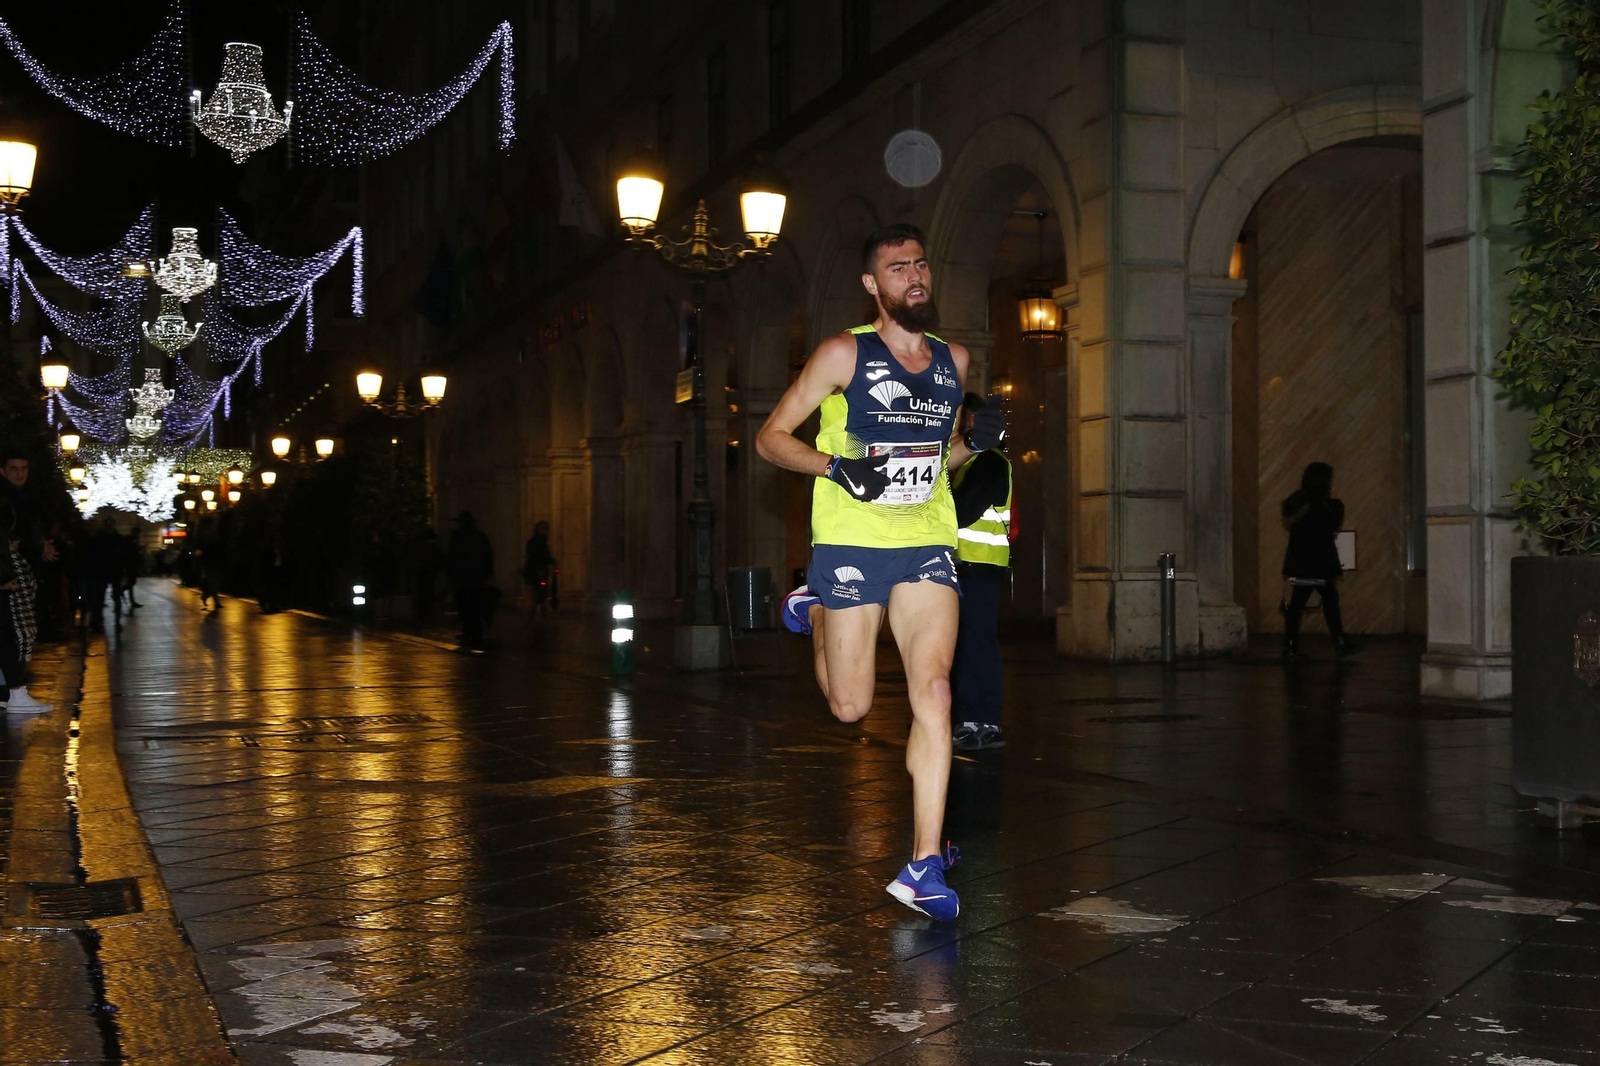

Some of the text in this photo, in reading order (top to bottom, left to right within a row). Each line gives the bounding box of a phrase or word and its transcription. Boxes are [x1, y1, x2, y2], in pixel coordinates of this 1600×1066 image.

[909, 397, 952, 416] Unicaja
[878, 414, 942, 427] Fundación Jaén
